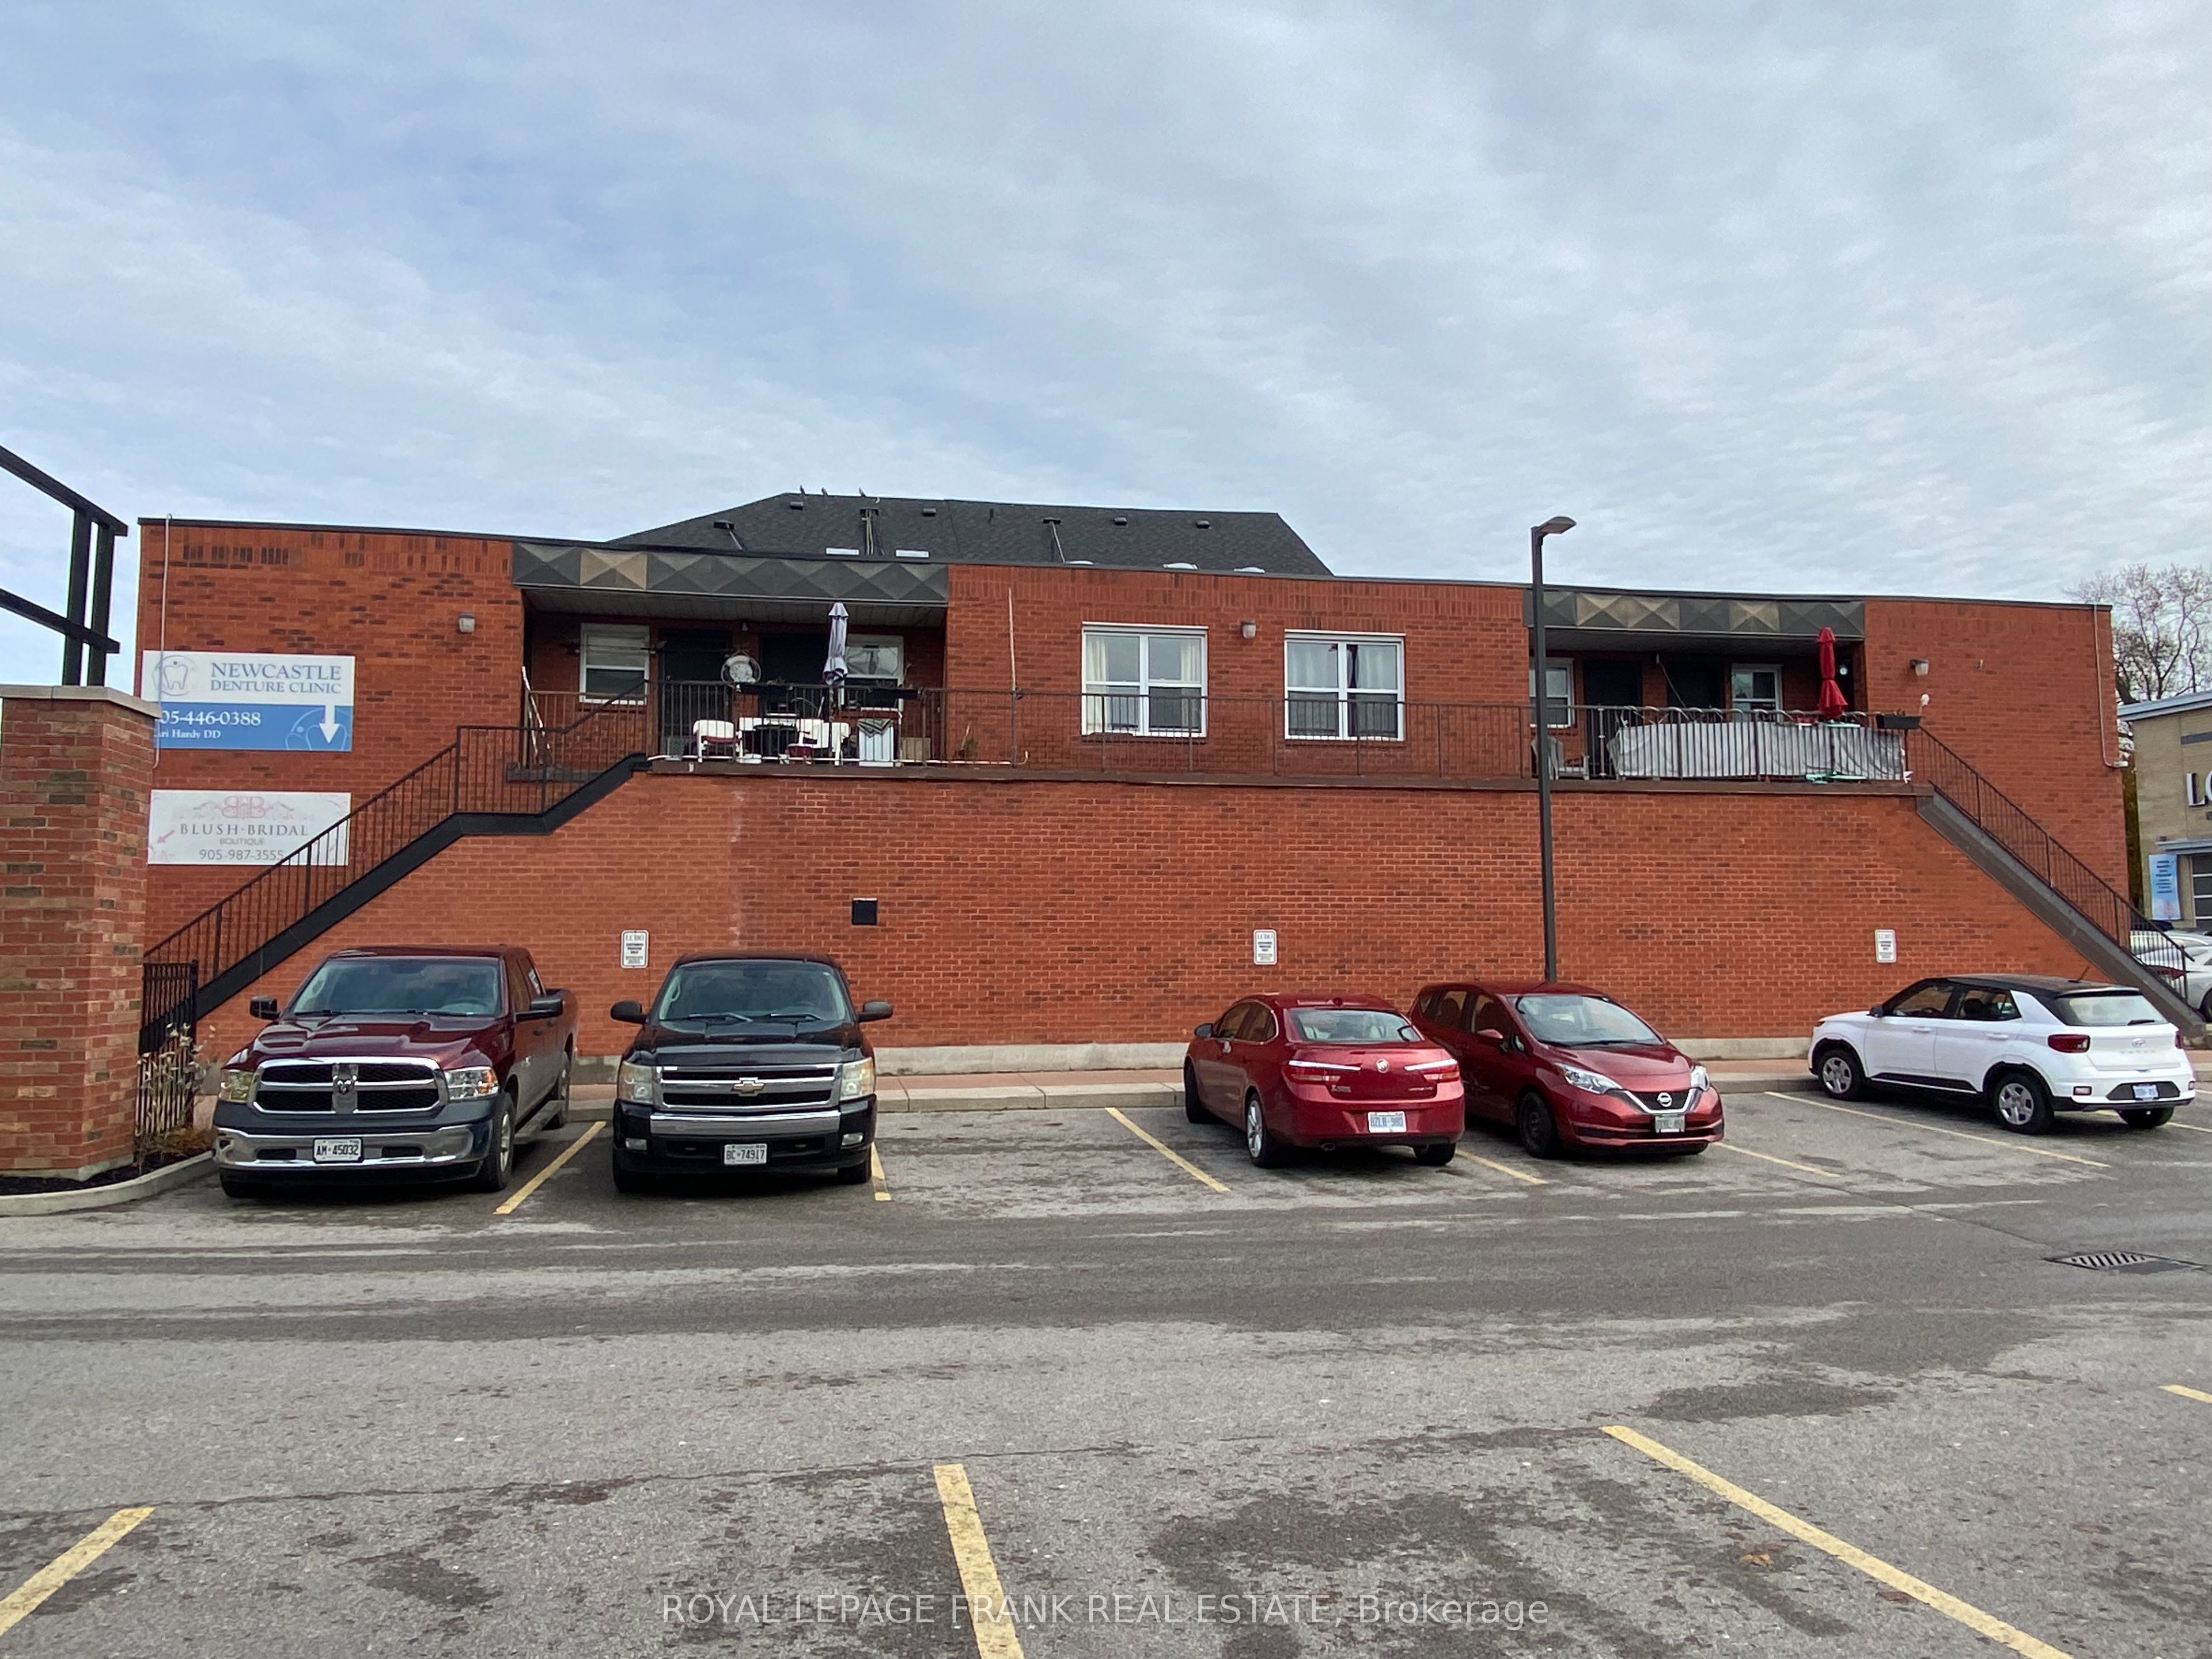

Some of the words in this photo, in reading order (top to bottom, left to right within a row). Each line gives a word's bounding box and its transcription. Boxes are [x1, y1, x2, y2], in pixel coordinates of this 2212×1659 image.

[211, 662, 342, 680] NEWCASTLE
[210, 680, 285, 692] DENTURE
[289, 682, 342, 694] CLINIC
[160, 710, 262, 726] 05-446-0388
[172, 729, 202, 740] Hardy
[203, 730, 221, 738] DD
[219, 838, 266, 846] BOUTIQUE
[199, 849, 284, 861] 905-987-3555
